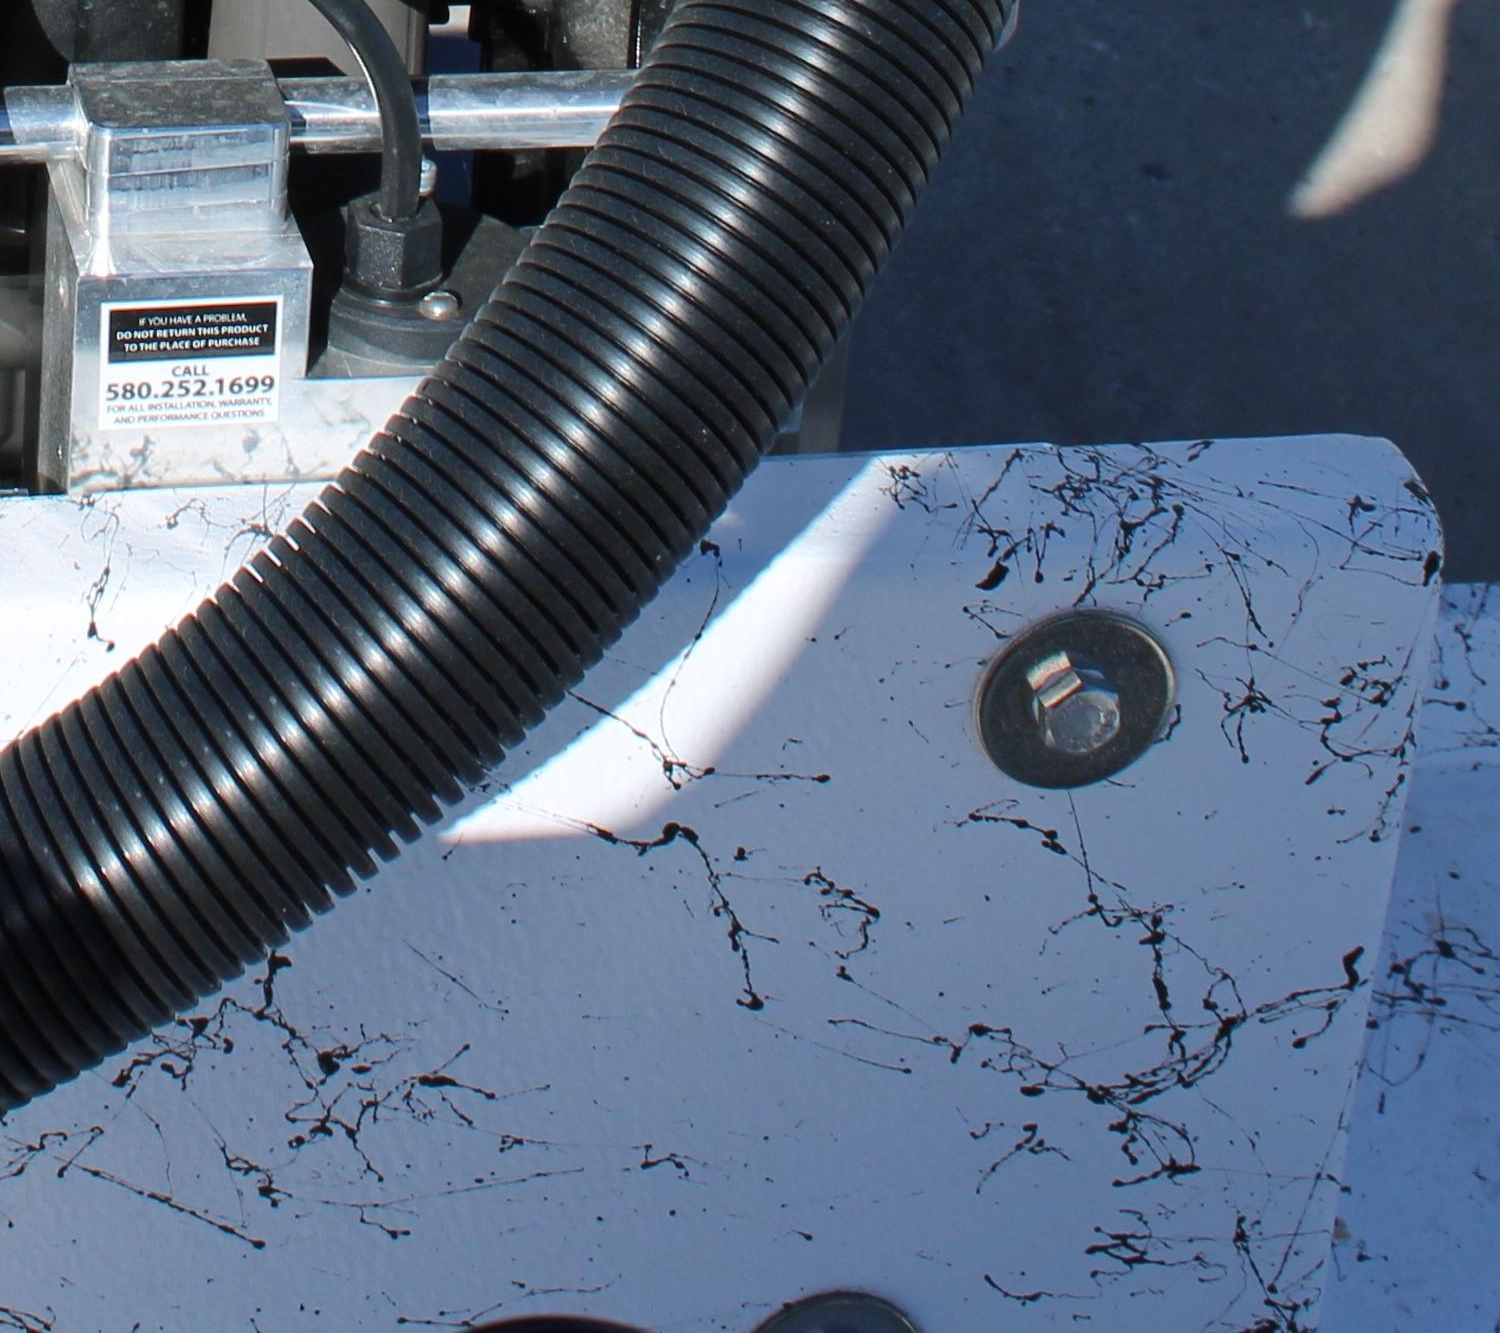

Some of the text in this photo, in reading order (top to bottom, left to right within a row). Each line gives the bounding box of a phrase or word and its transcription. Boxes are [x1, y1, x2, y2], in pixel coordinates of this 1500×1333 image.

[138, 317, 147, 326] IF
[148, 316, 167, 326] YOU
[169, 314, 193, 325] HAVE
[195, 315, 201, 324] A
[116, 323, 269, 340] DO NOT RETURN THIS PRODUCT
[124, 336, 260, 352] TO THE PLACE OF PURCHASE
[171, 365, 209, 377] CALL
[106, 375, 275, 401] 580.252.1699
[107, 404, 126, 413] FOR
[128, 403, 145, 412] ALL
[114, 409, 264, 424] AND PERFORMANCE QUESTIONS
